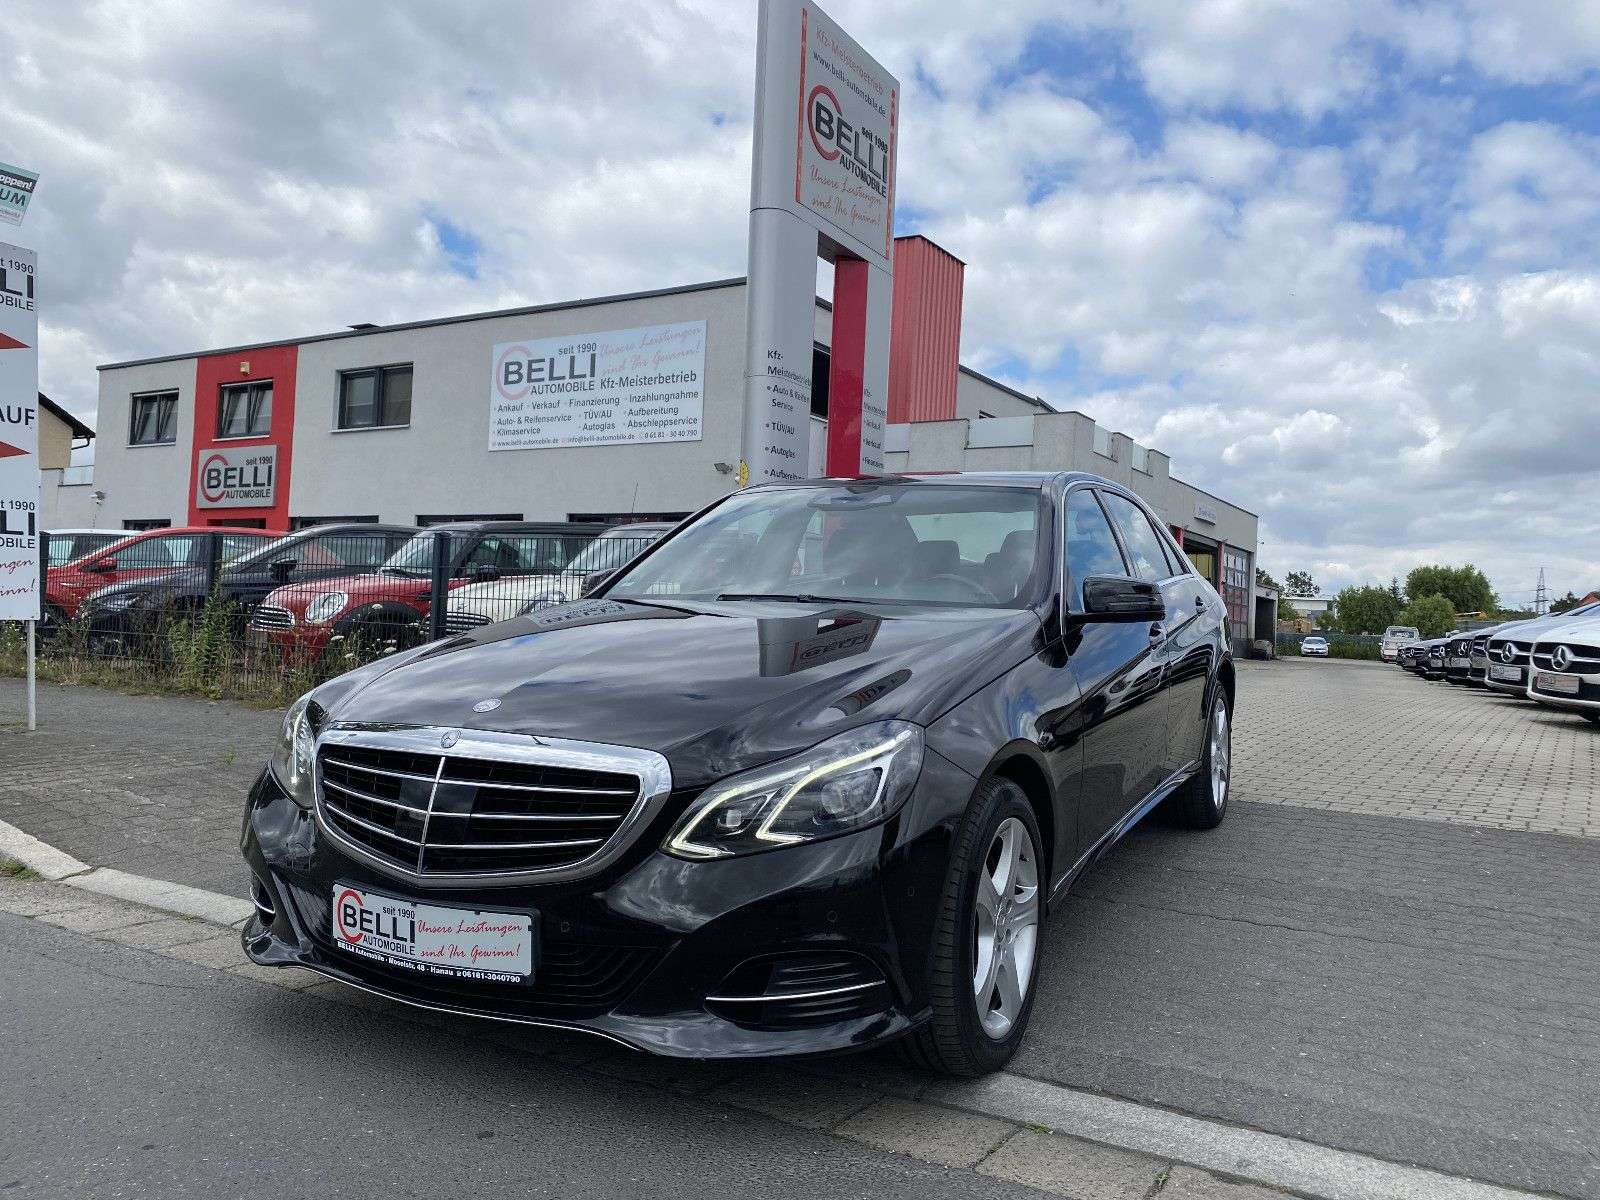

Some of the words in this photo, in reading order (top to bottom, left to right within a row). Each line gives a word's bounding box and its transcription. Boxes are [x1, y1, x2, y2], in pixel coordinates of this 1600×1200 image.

[815, 100, 888, 184] BELLI
[839, 153, 887, 199] AUTOMOBILE
[558, 345, 575, 356] seit
[577, 342, 597, 355] 1990
[767, 349, 784, 360] Kfz-
[503, 352, 597, 386] BELLI
[530, 380, 596, 395] AUTOMOBILE
[600, 370, 698, 390] Kfz-Meisterbetrieb
[497, 403, 524, 413] Ankauf
[531, 400, 561, 411] Verkauf
[569, 397, 621, 408] Finanzierung
[629, 391, 700, 404] Inzahlungnahme
[524, 414, 573, 424] Reifenservice
[627, 406, 680, 418] Aufbereitung
[497, 428, 542, 437] Klimaservice
[582, 423, 617, 433] Autoglas
[627, 417, 699, 430] Abschleppservice
[206, 465, 273, 489] BELLI
[225, 489, 271, 500] AUTOMOBILE
[8, 500, 35, 510] 1990
[382, 906, 395, 916] seit
[398, 908, 415, 919] 1990
[343, 903, 415, 943] BELLI
[416, 919, 452, 934] Unsere
[455, 920, 522, 938] Leistungen
[363, 934, 415, 955] AUTOMOBILE
[337, 940, 354, 953] BELLI
[430, 966, 454, 976] Hanau
[462, 970, 521, 983] 06181-3040790
